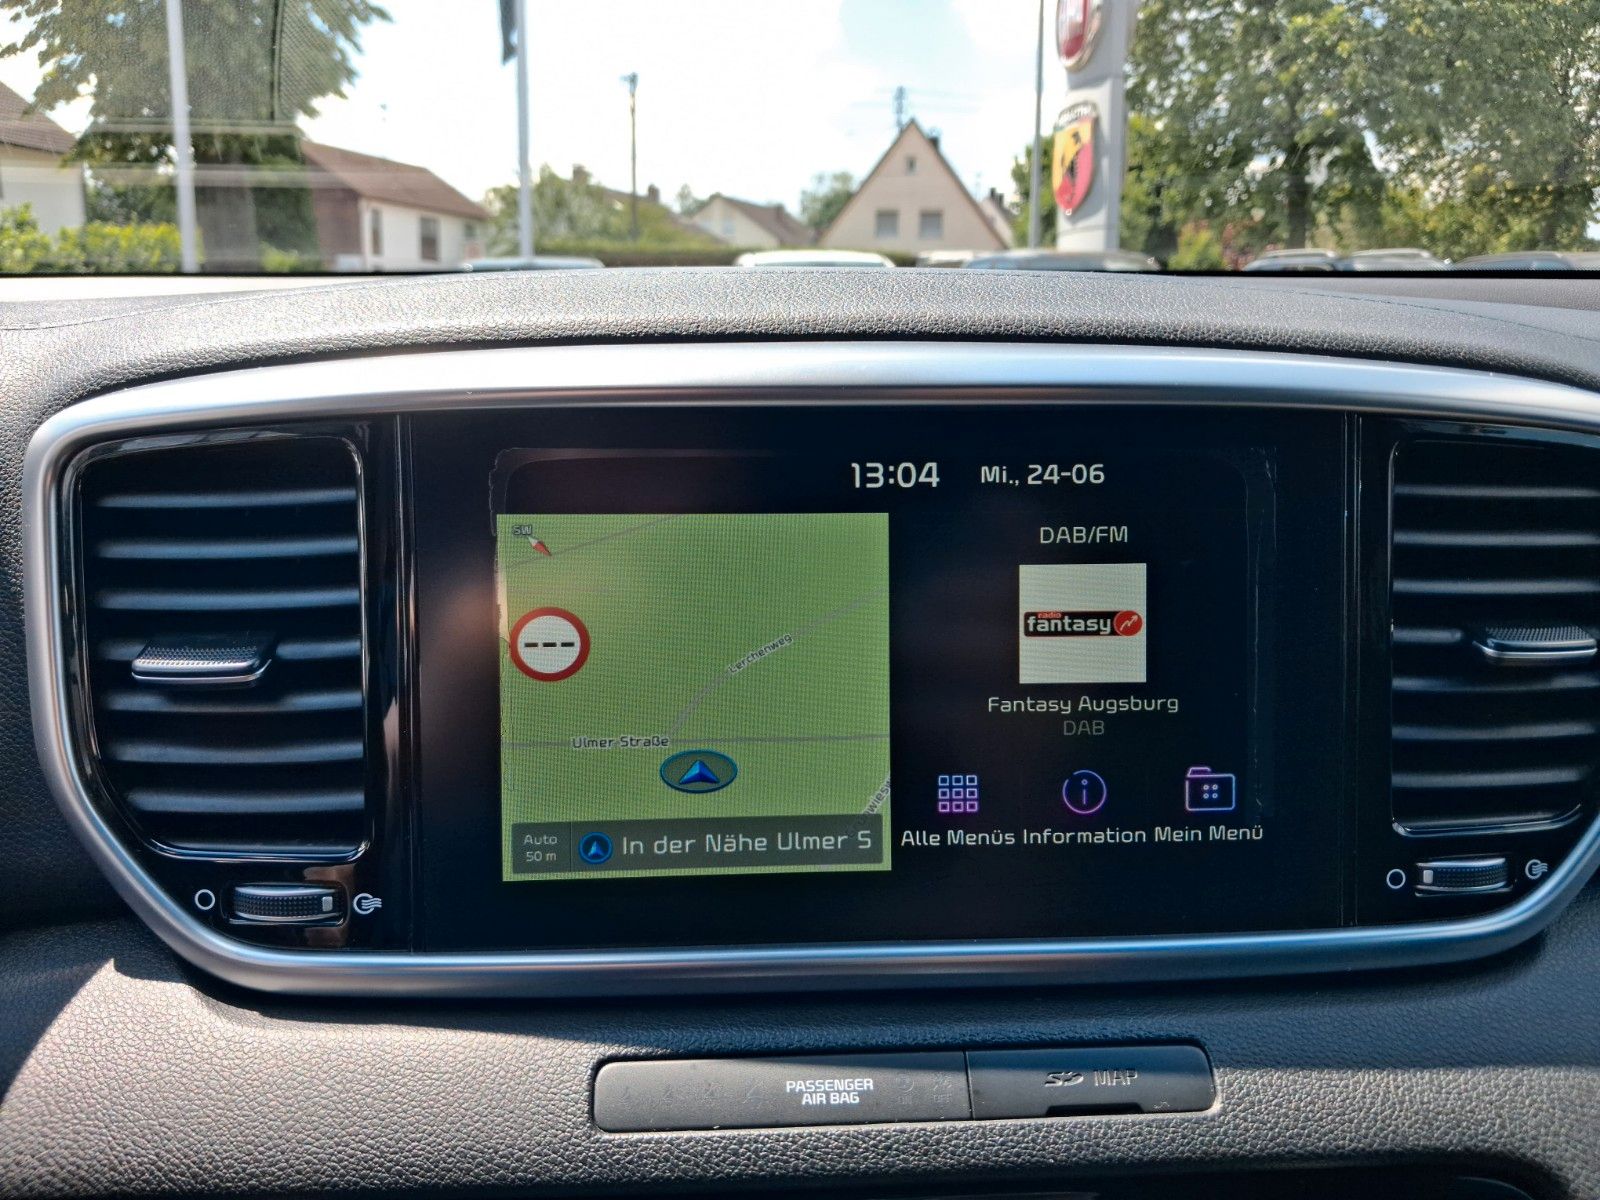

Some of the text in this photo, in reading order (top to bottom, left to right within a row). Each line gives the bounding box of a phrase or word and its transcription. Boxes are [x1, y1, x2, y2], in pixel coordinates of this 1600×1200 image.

[851, 462, 940, 488] 13:04
[980, 463, 1106, 486] Mi., 24-06
[512, 524, 533, 536] SW
[1039, 526, 1129, 544] DAB/FM
[1037, 611, 1062, 619] radio
[1027, 616, 1112, 635] fantasy
[728, 634, 793, 673] Lerchenweg
[988, 695, 1180, 714] Fantasy Augsburg
[1063, 720, 1105, 736] DAB
[572, 735, 670, 749] Ulmer Straße
[524, 834, 558, 846] Auto
[901, 829, 1016, 846] Alle Menüs
[1023, 827, 1147, 844] Information
[1154, 824, 1264, 842] Mein Menü
[623, 830, 872, 855] In der Nähe Ulmer S
[525, 851, 557, 863] 50 m
[786, 1078, 874, 1093] PASSENGER
[1093, 1068, 1138, 1087] MAP
[802, 1092, 860, 1105] AIR BAG
